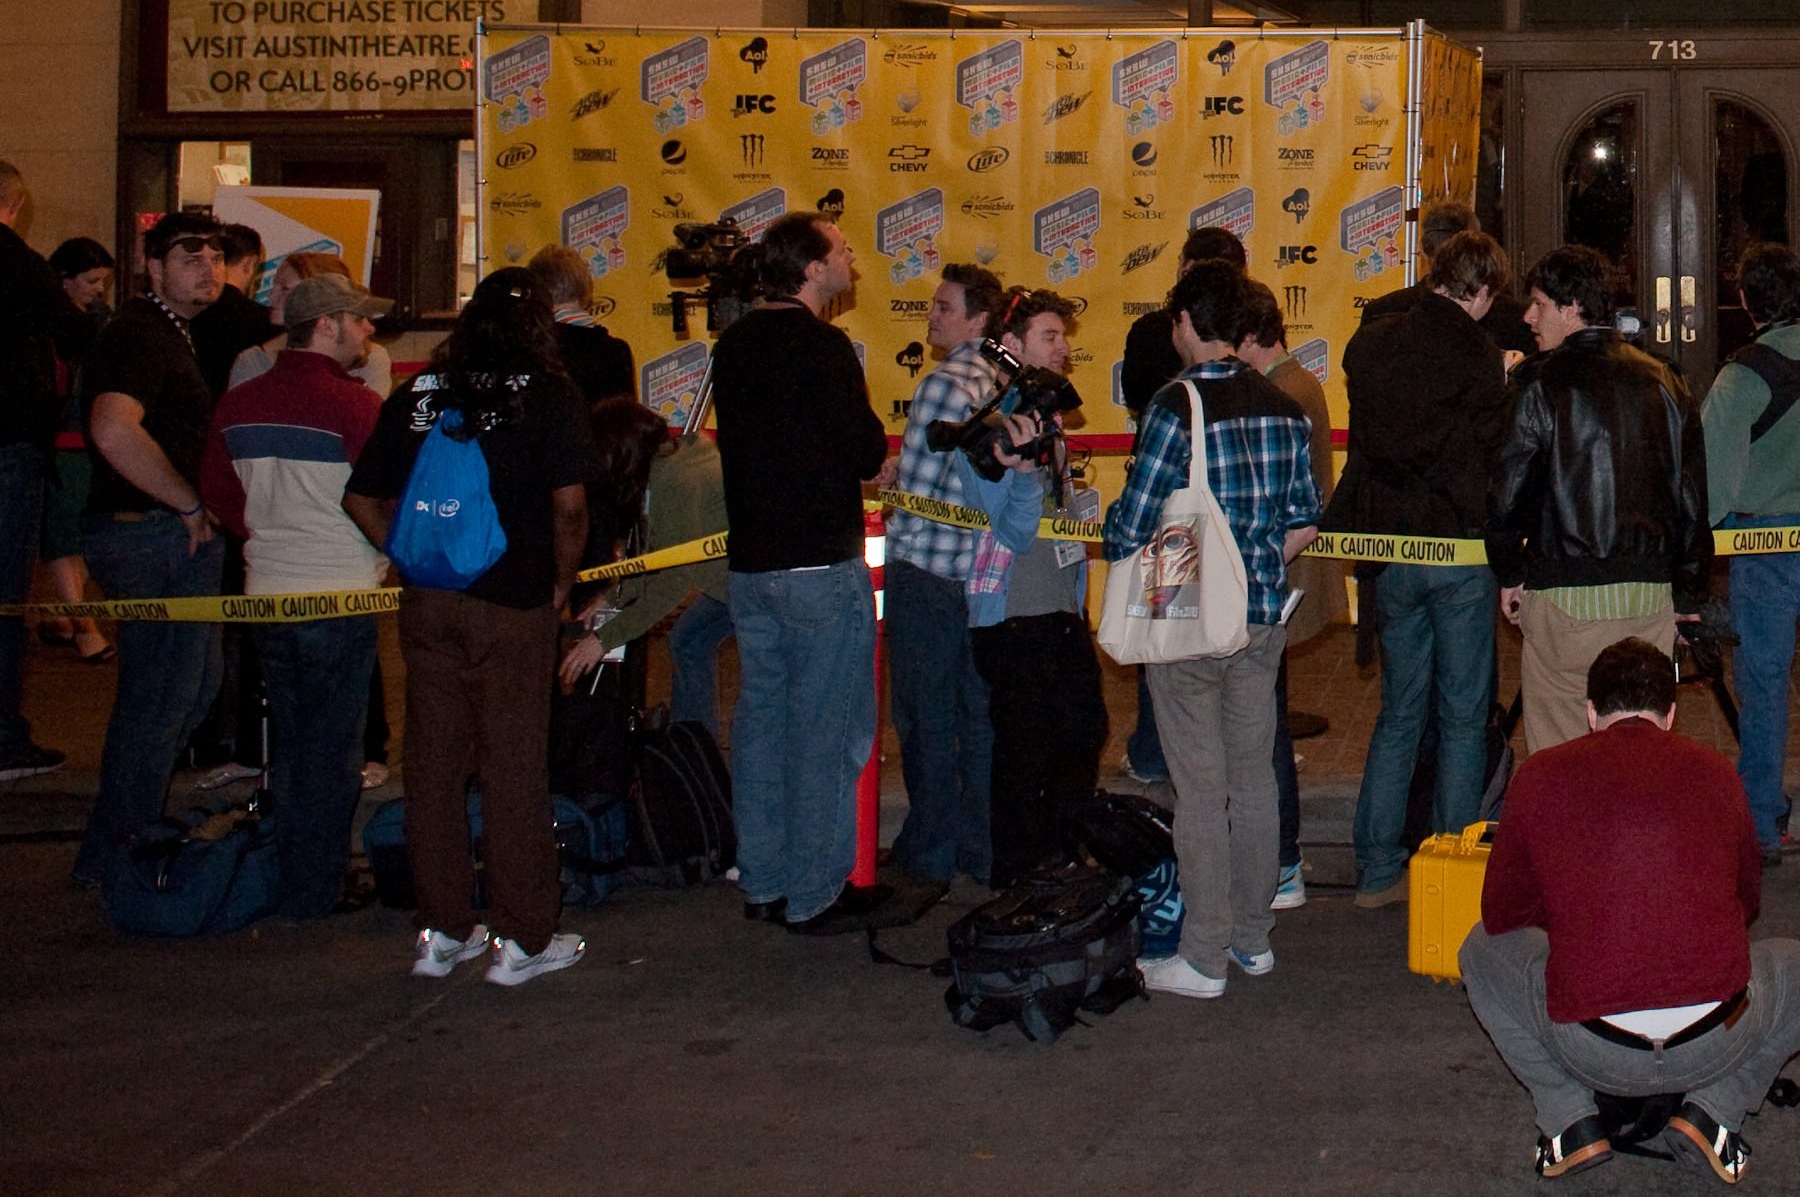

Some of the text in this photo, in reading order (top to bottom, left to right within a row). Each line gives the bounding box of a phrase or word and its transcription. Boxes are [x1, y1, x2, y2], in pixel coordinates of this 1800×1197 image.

[210, 0, 505, 24] TO PURCHASE TICKETS
[183, 34, 475, 58] VISIT AUSTINTHEATRE.
[1648, 40, 1697, 60] 713
[896, 51, 937, 61] sonicbids
[1358, 52, 1398, 62] sonicbids
[209, 70, 251, 93] OR
[259, 69, 326, 93] CALL
[735, 94, 777, 114] IFC
[1204, 96, 1245, 115] IFC
[1354, 117, 1389, 128] Silverlight
[811, 147, 849, 160] ZONE
[974, 153, 1003, 170] Lite
[1278, 147, 1314, 160] ZONE
[890, 162, 928, 173] CHEVY
[1353, 162, 1391, 171] CHEVY
[973, 202, 1015, 212] sonicbids
[1279, 245, 1319, 264] IFC
[1341, 536, 1395, 558] CAUTION
[1401, 540, 1455, 562] CAUTION
[1733, 531, 1783, 551] CAUTION
[588, 559, 647, 582] CAUTION
[114, 602, 169, 619] CAUTION
[222, 598, 276, 619] CAUTION
[281, 595, 339, 618] CAUTION
